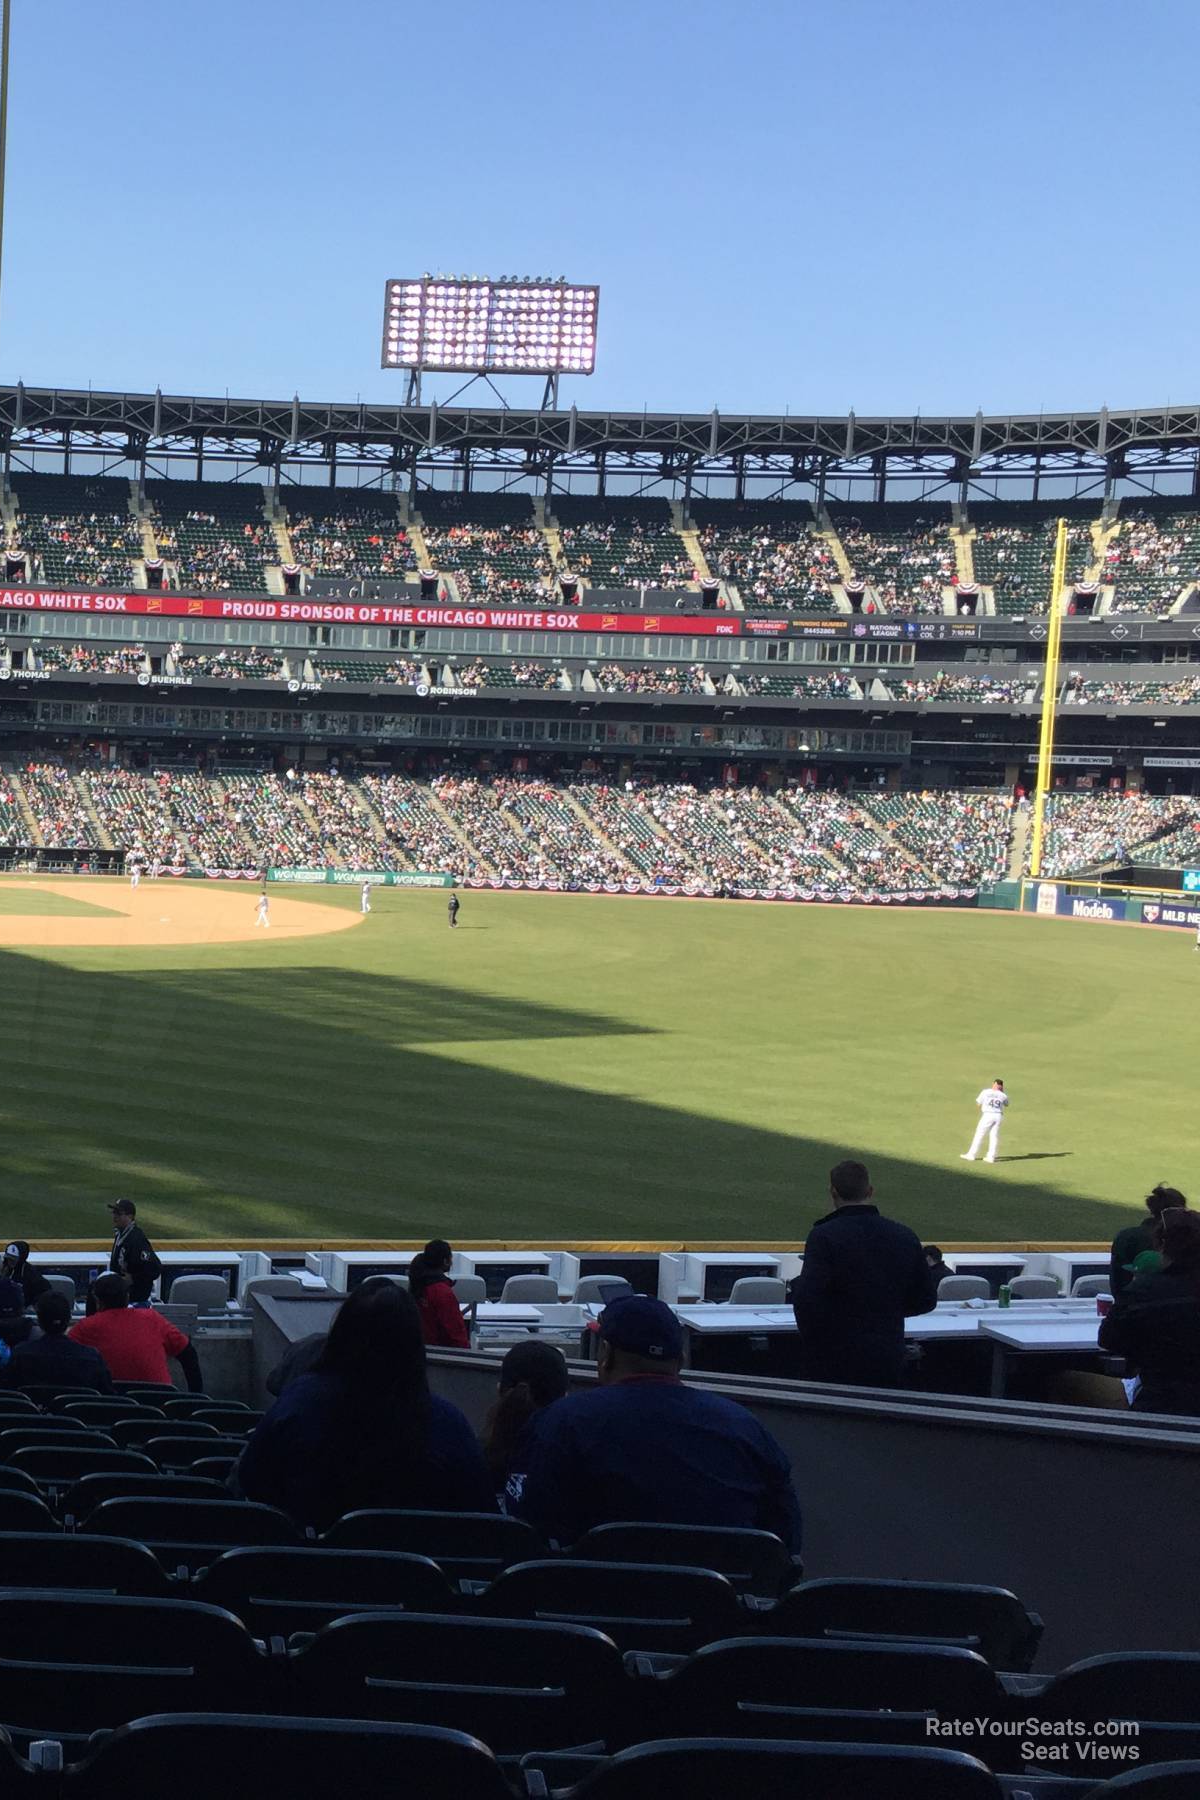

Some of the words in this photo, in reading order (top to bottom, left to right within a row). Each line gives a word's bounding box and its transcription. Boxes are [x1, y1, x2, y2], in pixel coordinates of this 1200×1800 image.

[39, 594, 90, 608] WHITE
[95, 596, 126, 610] SOX
[223, 602, 275, 617] PROUD
[280, 604, 354, 620] SPONSOR
[359, 608, 379, 621] OF
[383, 608, 412, 623] THE
[416, 609, 486, 625] CHICAGO
[490, 612, 542, 627] WHITE
[546, 614, 579, 628] SOX
[716, 625, 734, 634] FDIC
[13, 671, 50, 679] THOMAS
[152, 676, 192, 684] BUEHRLE
[430, 687, 477, 695] ROBINSON
[274, 870, 297, 879] WGN
[334, 873, 358, 881] WGN
[393, 875, 417, 884] WGN
[1073, 900, 1113, 919] Modelo
[1162, 910, 1185, 922] MLB
[989, 1099, 1001, 1108] 49
